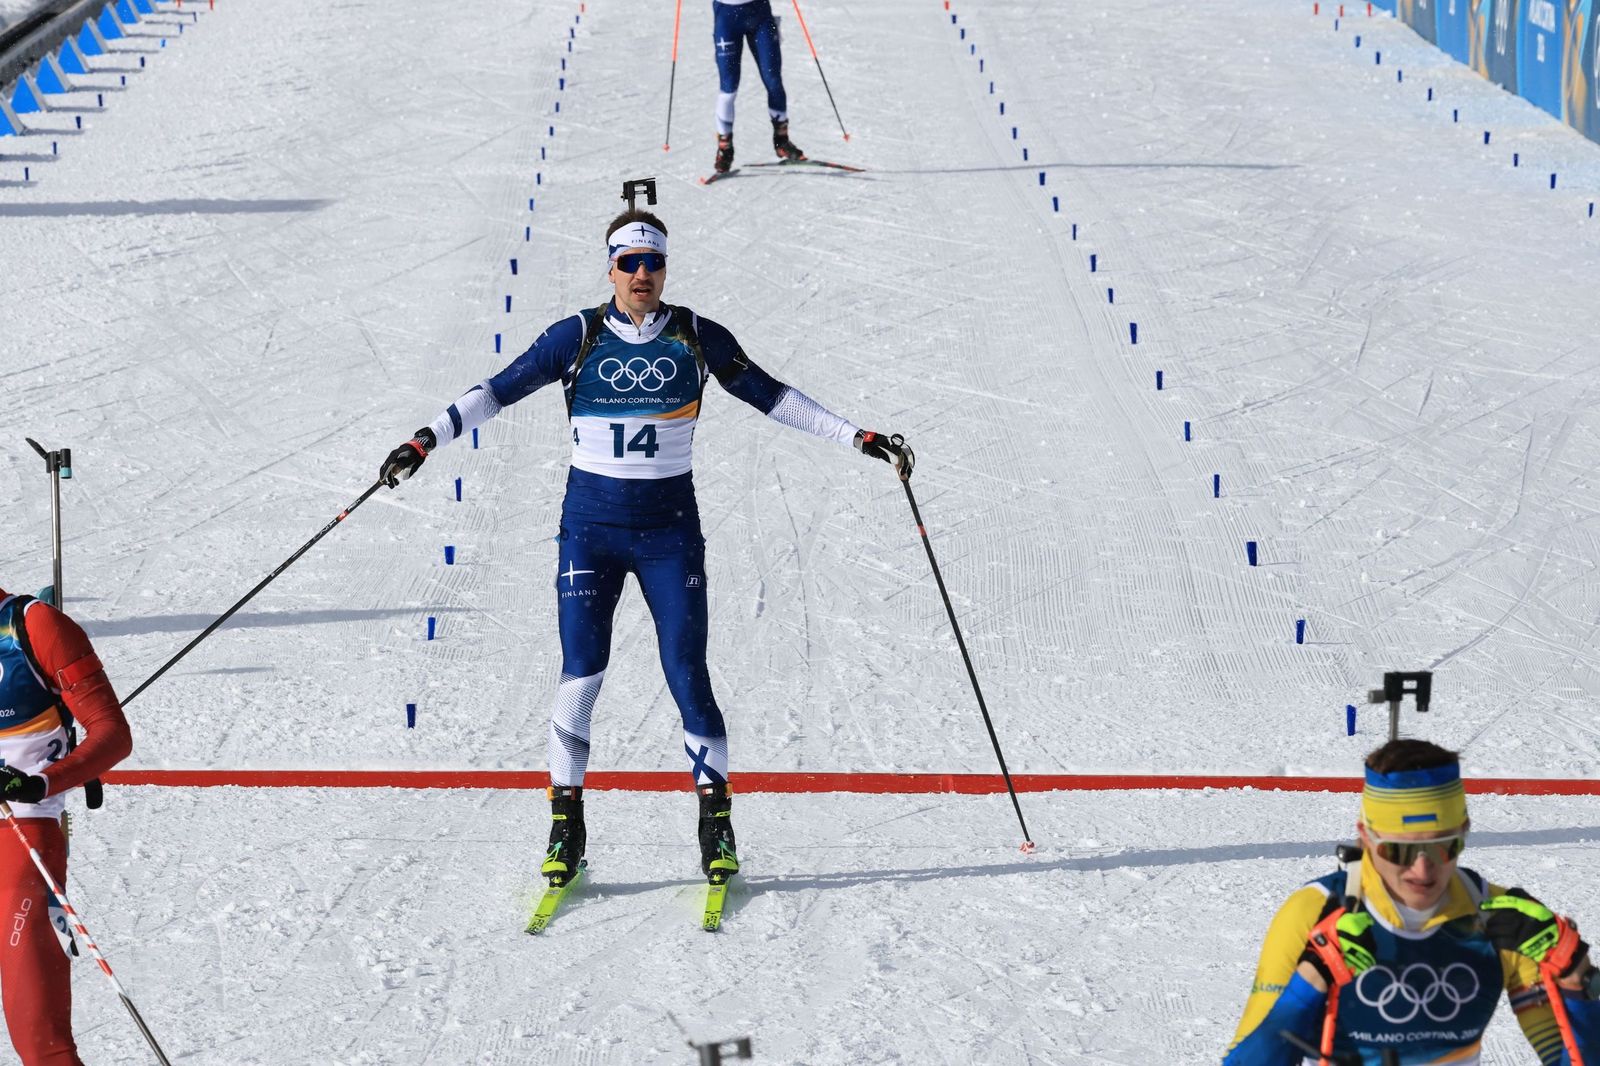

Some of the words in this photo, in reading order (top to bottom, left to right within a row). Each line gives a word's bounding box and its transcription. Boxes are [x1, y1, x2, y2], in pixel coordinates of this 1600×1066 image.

[609, 422, 660, 459] 14
[561, 589, 598, 599] FINLAND
[9, 897, 33, 947] odlo
[1348, 1030, 1404, 1043] MILANO
[1406, 1030, 1459, 1042] CORTINA
